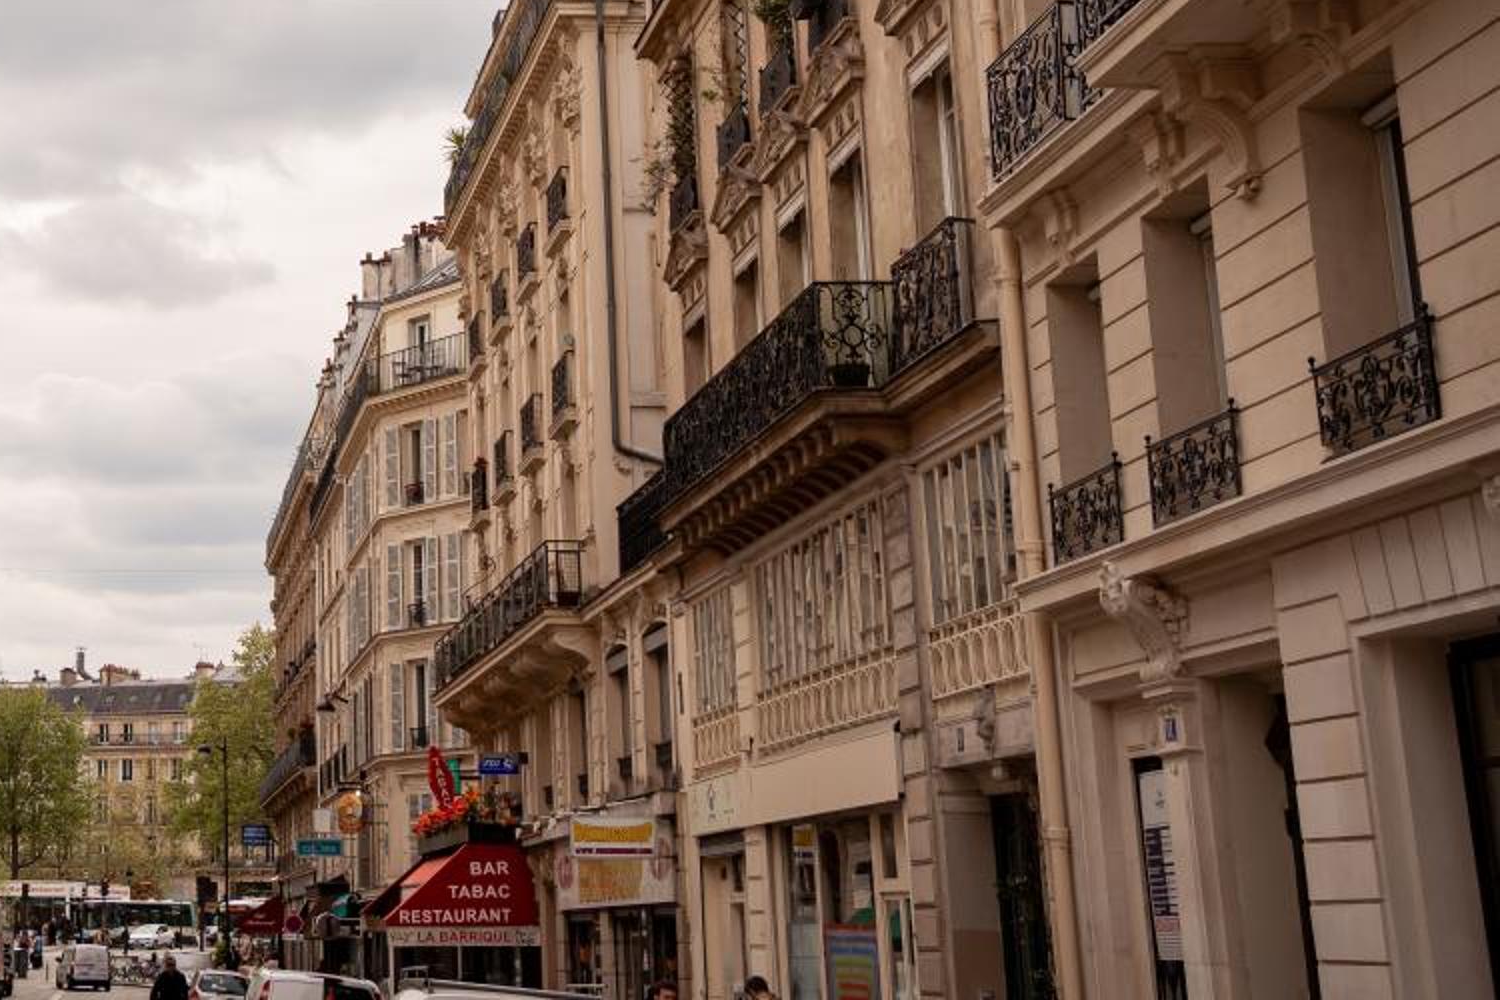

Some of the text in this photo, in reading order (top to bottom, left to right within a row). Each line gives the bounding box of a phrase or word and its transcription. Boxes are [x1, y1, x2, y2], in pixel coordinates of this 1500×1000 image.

[469, 861, 510, 876] BAR
[448, 884, 511, 899] TABAC
[399, 908, 512, 924] RESTAURANT
[417, 930, 436, 943] LA
